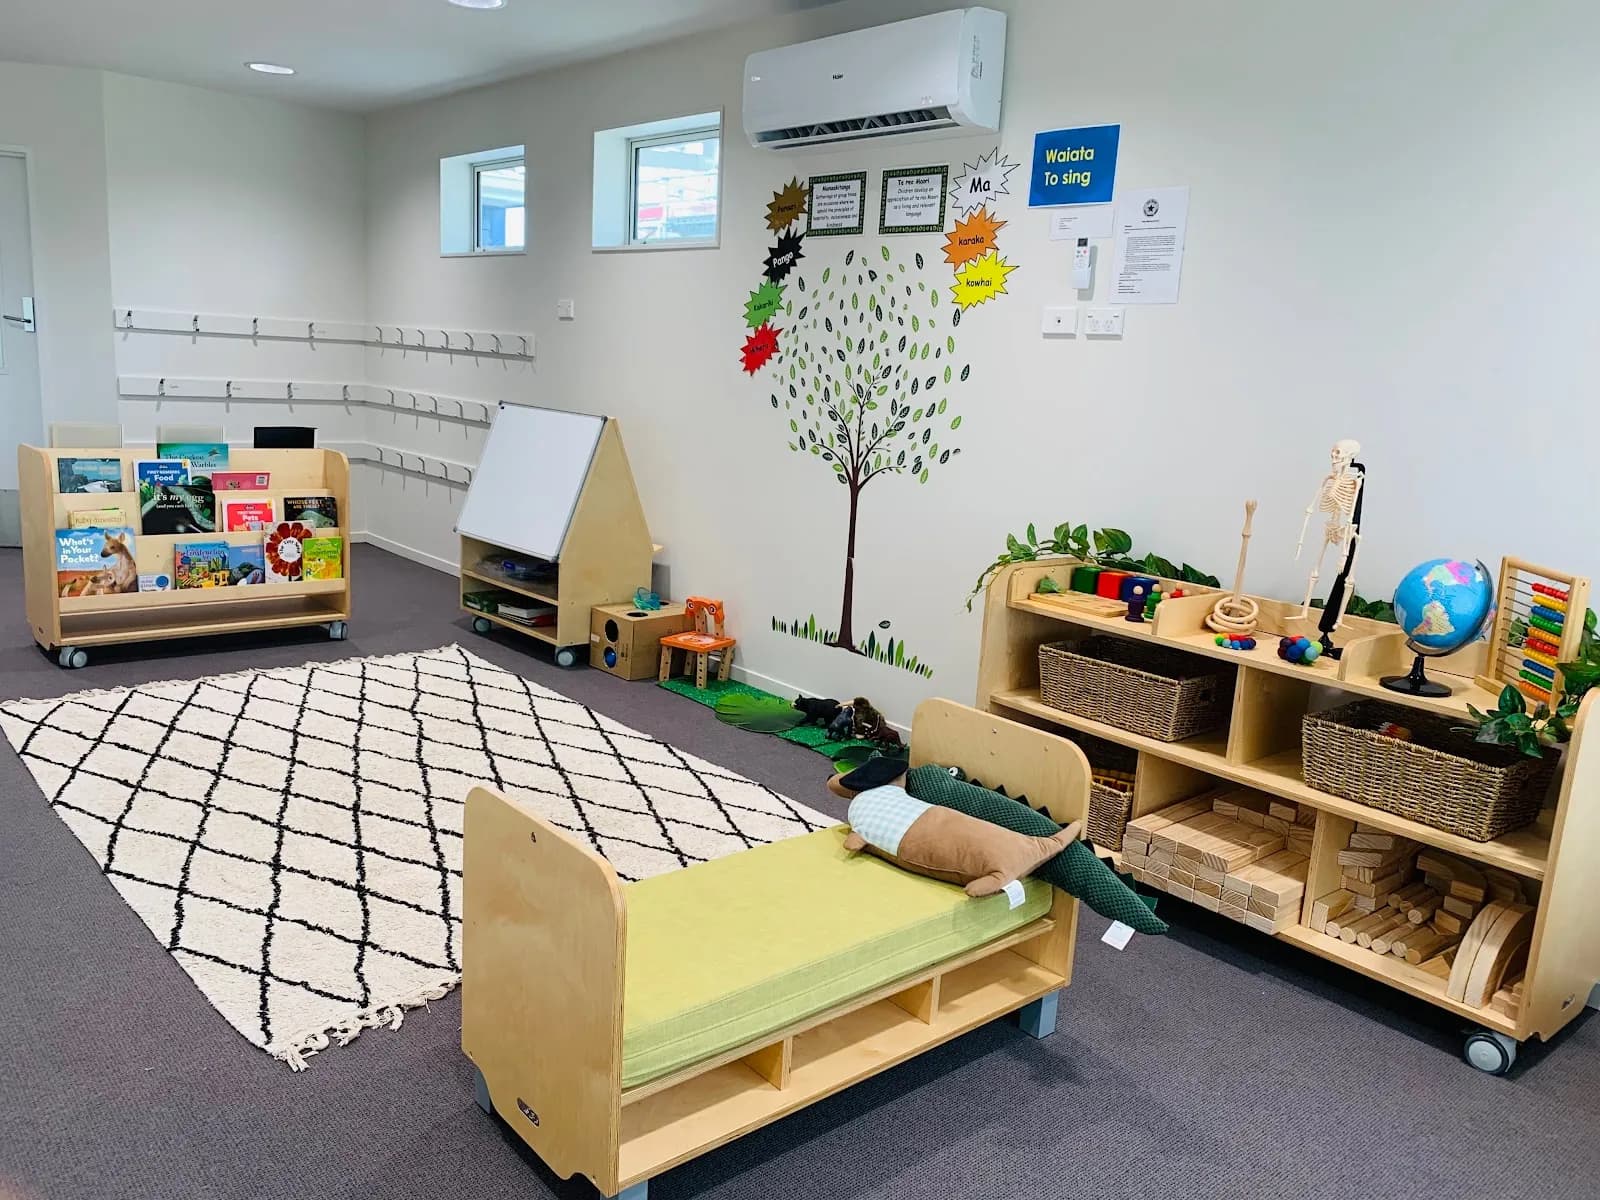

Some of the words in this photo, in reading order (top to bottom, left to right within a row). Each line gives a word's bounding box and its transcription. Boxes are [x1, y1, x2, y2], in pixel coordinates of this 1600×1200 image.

[1045, 145, 1095, 164] Waiata
[1044, 171, 1059, 186] To
[1061, 168, 1092, 187] sing
[969, 176, 991, 194] Ma
[958, 235, 985, 246] karaka
[772, 251, 794, 268] Pango
[965, 277, 993, 287] kowhai
[153, 492, 168, 501] it's
[169, 494, 184, 504] my
[59, 537, 94, 547] What's
[60, 554, 99, 564] Pocket?
